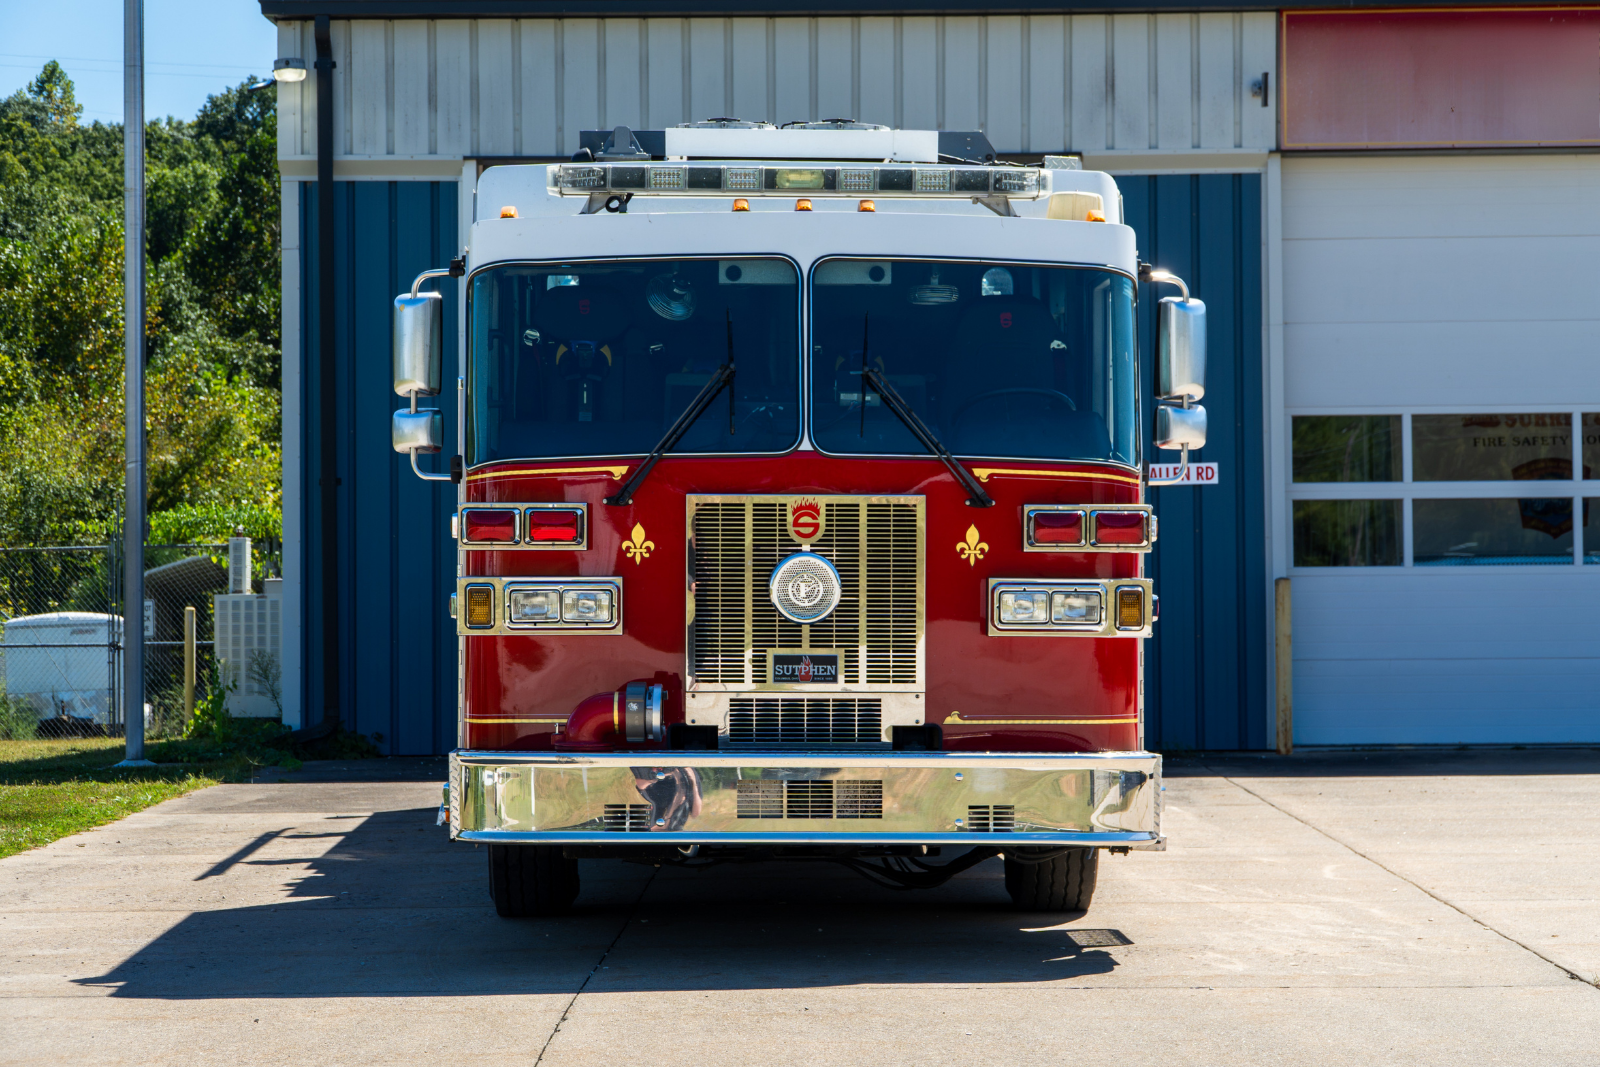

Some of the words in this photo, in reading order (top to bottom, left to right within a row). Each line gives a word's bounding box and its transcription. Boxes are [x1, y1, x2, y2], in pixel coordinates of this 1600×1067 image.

[1473, 436, 1506, 447] FIRE
[1512, 435, 1569, 446] SAFETY
[1196, 466, 1215, 481] RD
[775, 665, 836, 675] SUTPHEN
